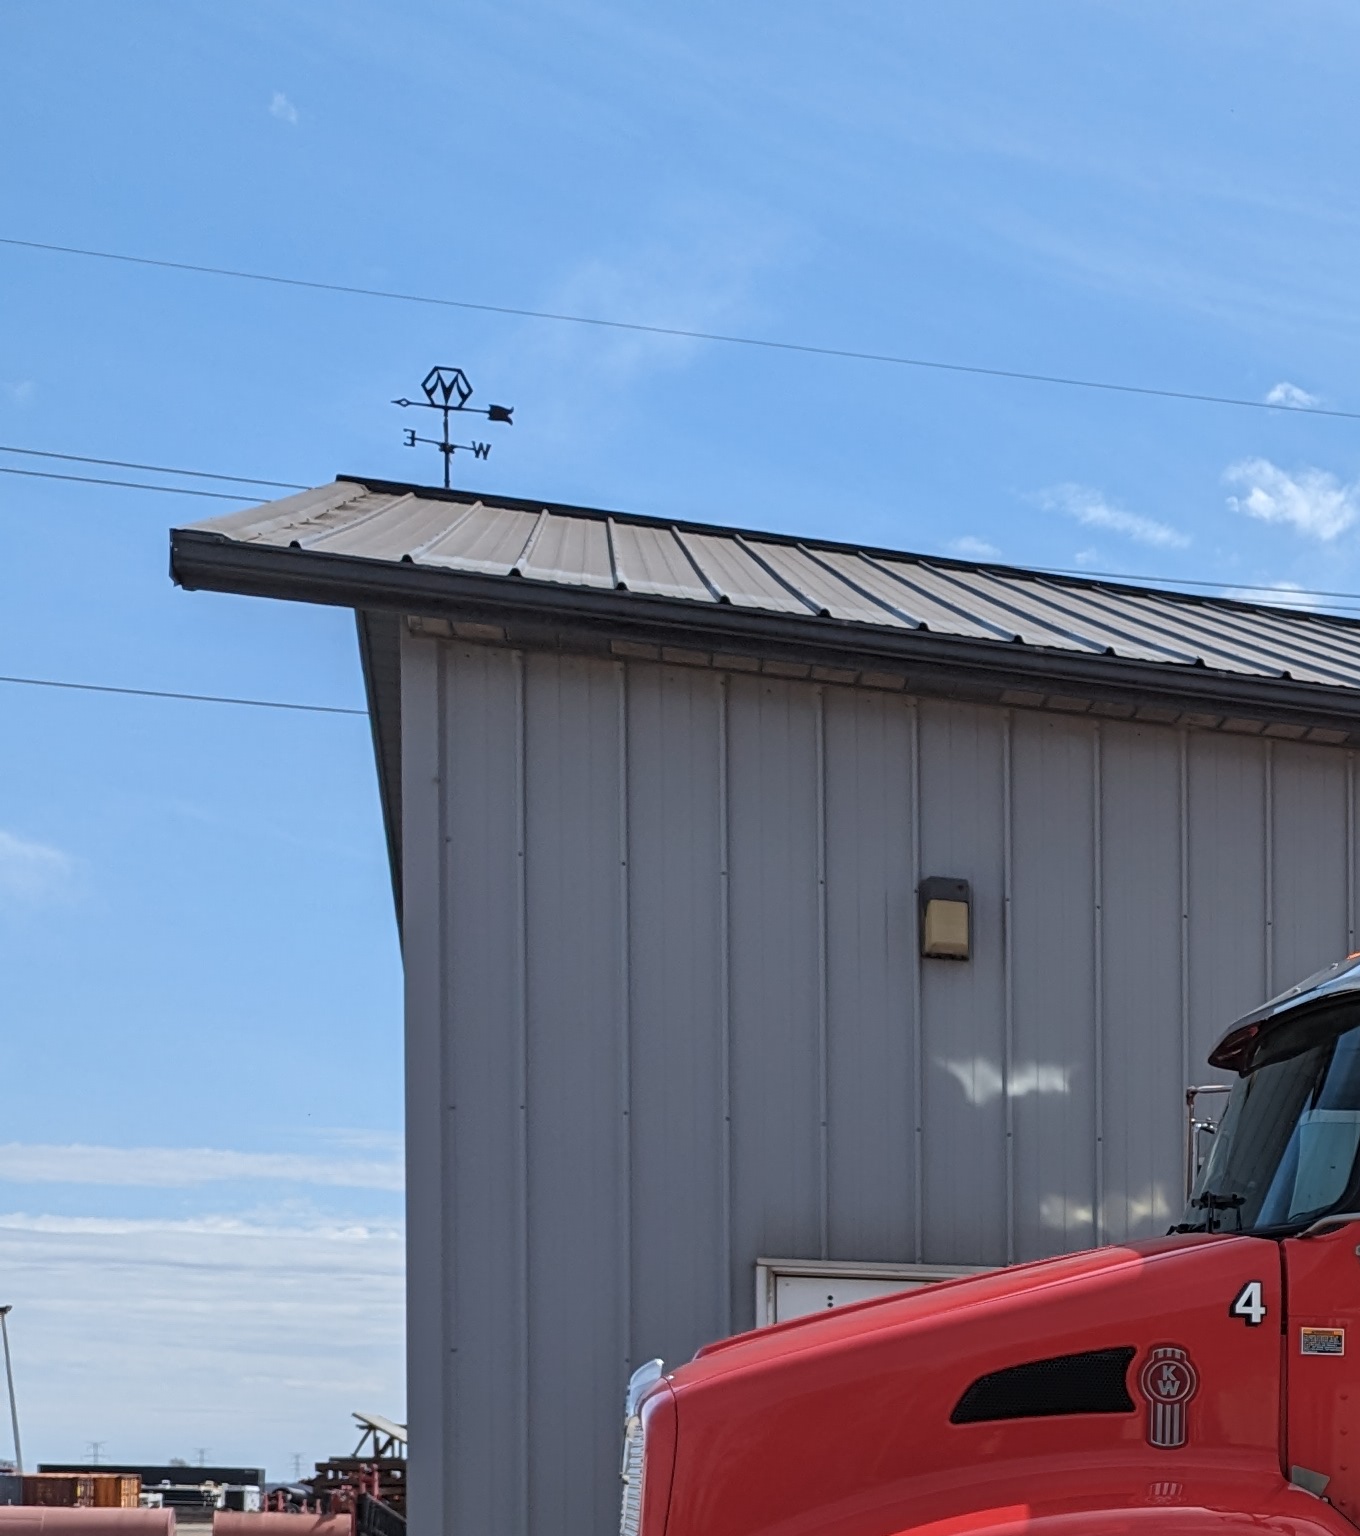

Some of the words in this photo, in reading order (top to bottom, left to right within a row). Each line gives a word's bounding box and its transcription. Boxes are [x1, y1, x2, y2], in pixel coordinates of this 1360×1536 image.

[1230, 1280, 1266, 1326] 4
[1163, 1365, 1176, 1380] K
[1157, 1380, 1179, 1396] W
